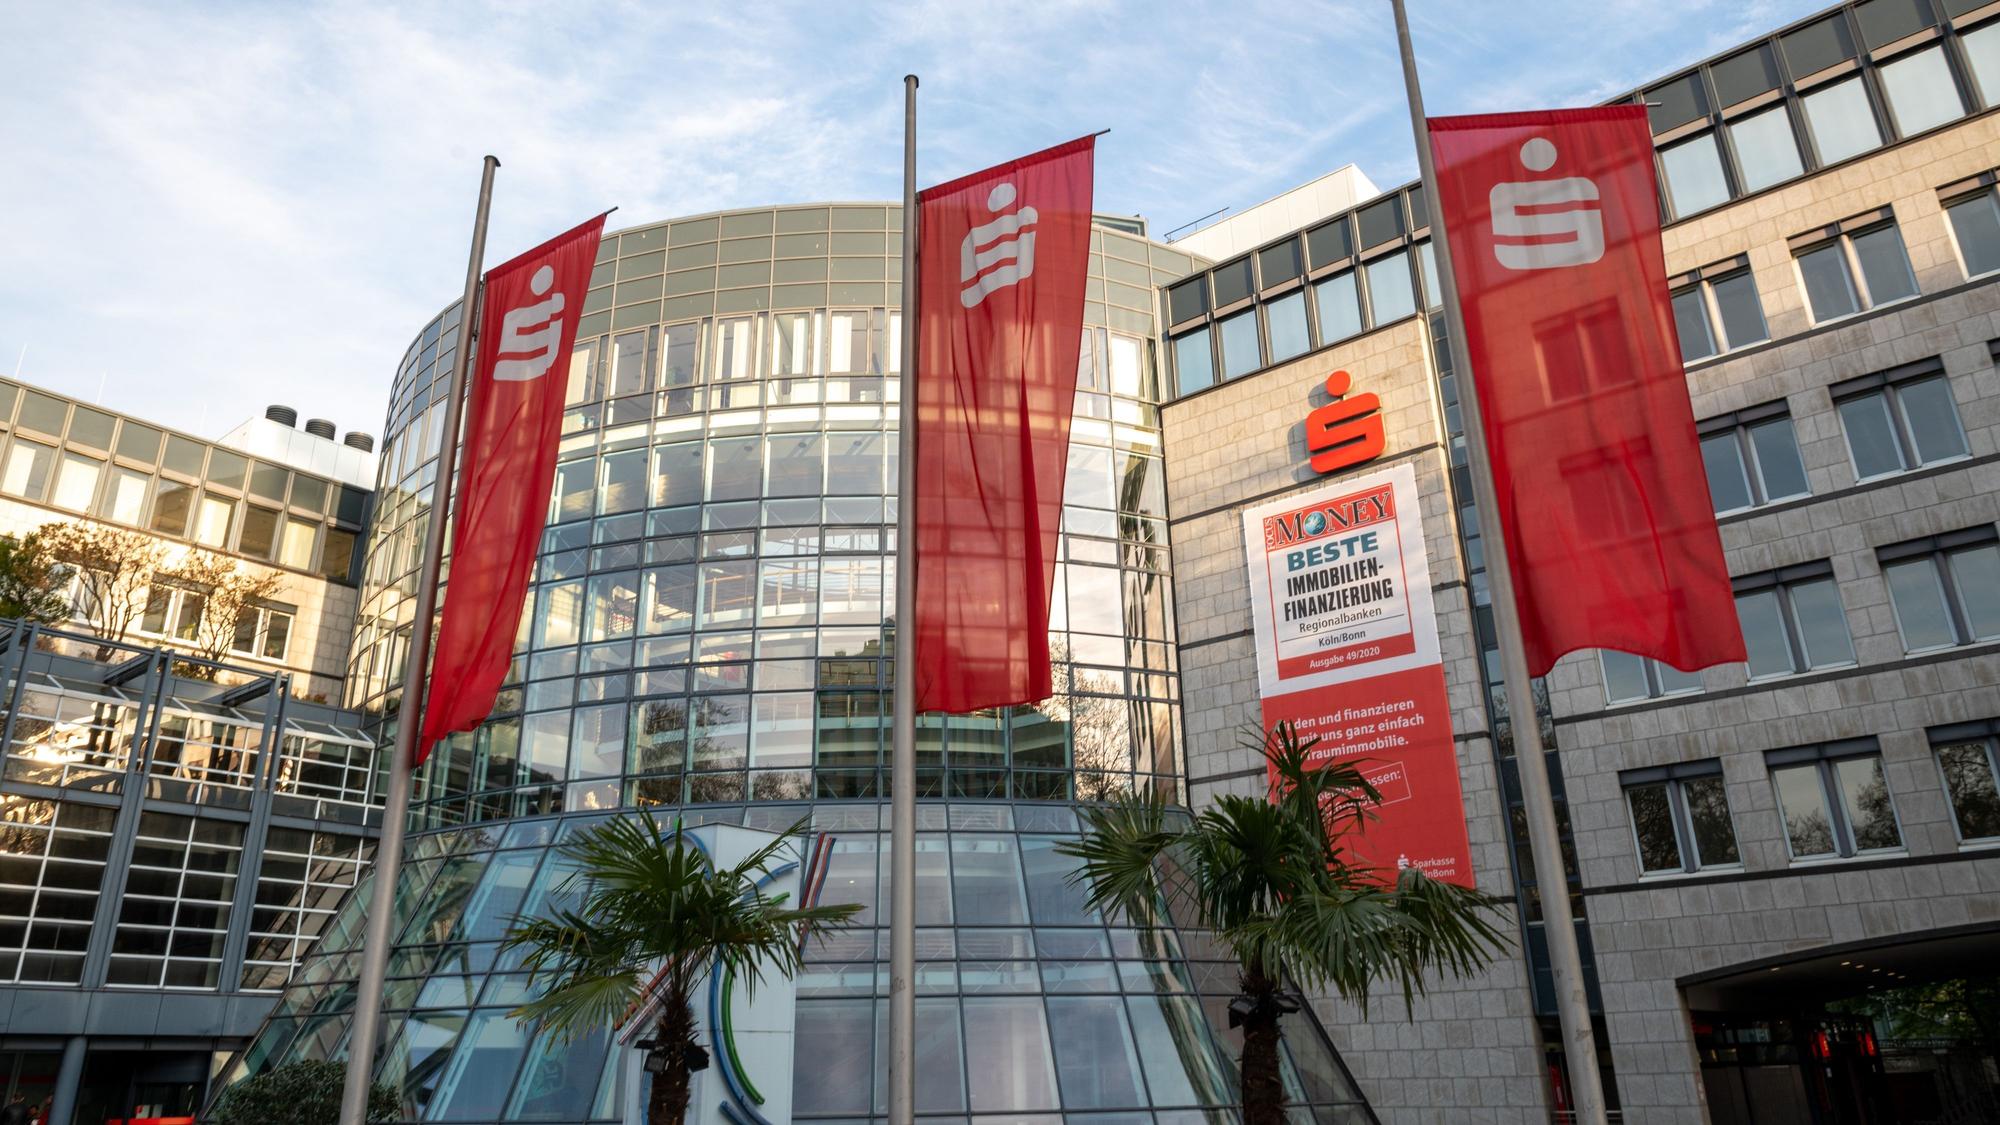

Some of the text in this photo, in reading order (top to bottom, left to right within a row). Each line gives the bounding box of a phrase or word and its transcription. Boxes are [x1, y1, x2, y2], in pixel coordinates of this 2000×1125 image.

[1276, 491, 1390, 544] MONEY
[1264, 517, 1276, 550] FOCUS
[1287, 531, 1379, 572] BESTE
[1287, 557, 1384, 597] IMMOBILIEN-
[1284, 578, 1394, 622] FINANZIERUNG
[1299, 607, 1382, 632] Regionalbanken
[1318, 630, 1366, 647] Köln/Bonn
[1309, 646, 1380, 669] Ausgabe 49/2020
[1319, 710, 1341, 725] und
[1343, 700, 1415, 721] finanzieren
[1321, 729, 1343, 741] uns
[1345, 723, 1376, 740] ganz
[1378, 713, 1424, 732] einfach
[1412, 857, 1456, 869] Sparkasse
